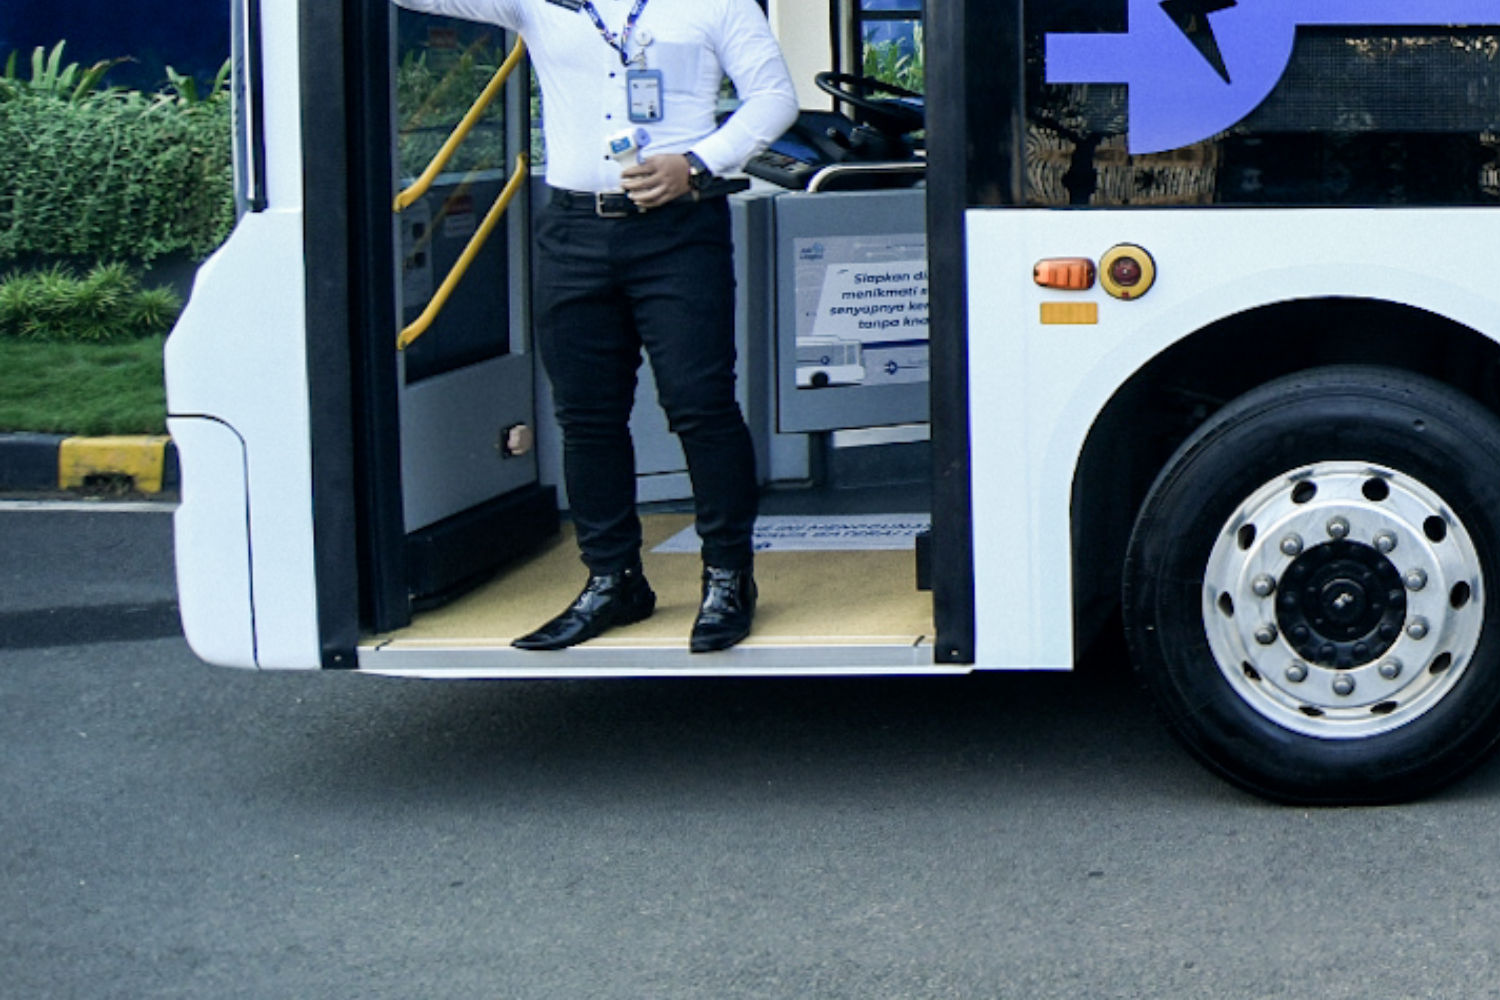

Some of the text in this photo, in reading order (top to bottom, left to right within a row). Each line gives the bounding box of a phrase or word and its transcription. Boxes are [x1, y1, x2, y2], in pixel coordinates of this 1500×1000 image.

[854, 271, 911, 285] Siapkan
[842, 286, 918, 299] menikmati
[858, 318, 900, 330] tanpa
